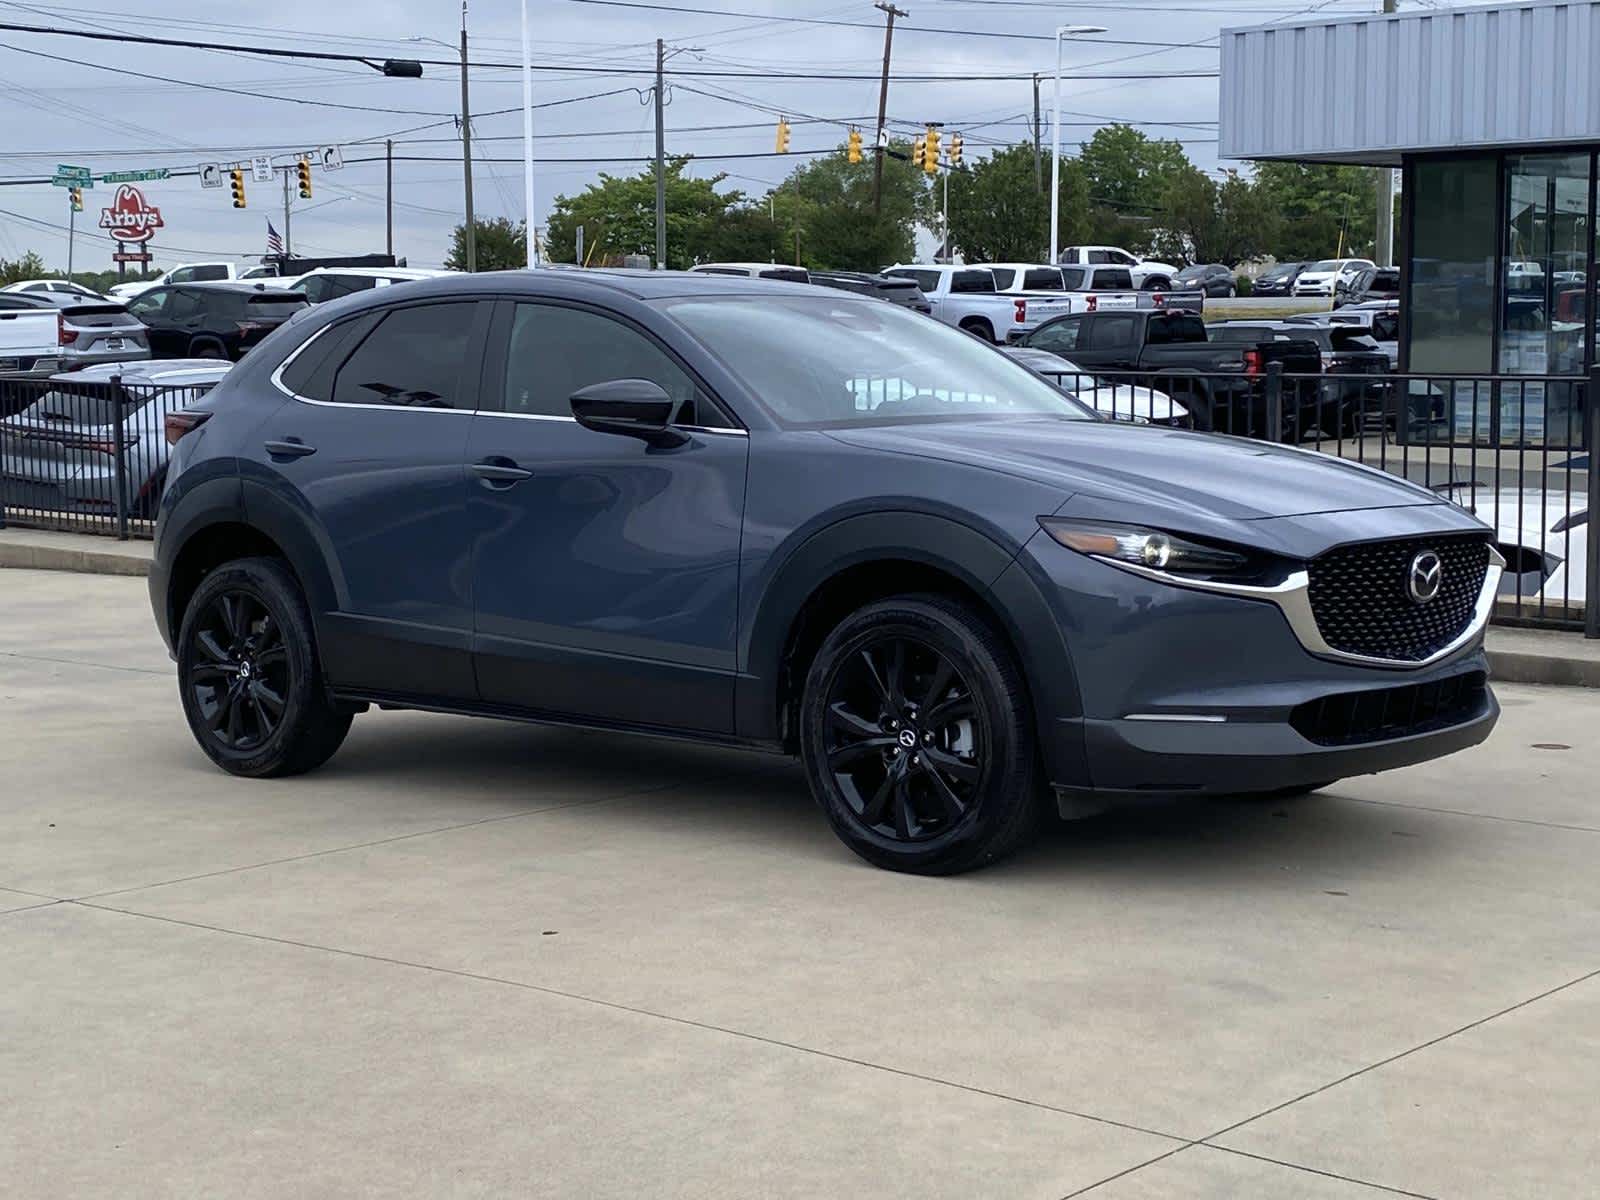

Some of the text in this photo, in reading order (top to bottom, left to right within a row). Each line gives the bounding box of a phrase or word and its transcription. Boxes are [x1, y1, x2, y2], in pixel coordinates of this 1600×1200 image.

[325, 162, 340, 170] ONLY
[204, 179, 220, 187] ONLY
[100, 207, 158, 231] Arby's
